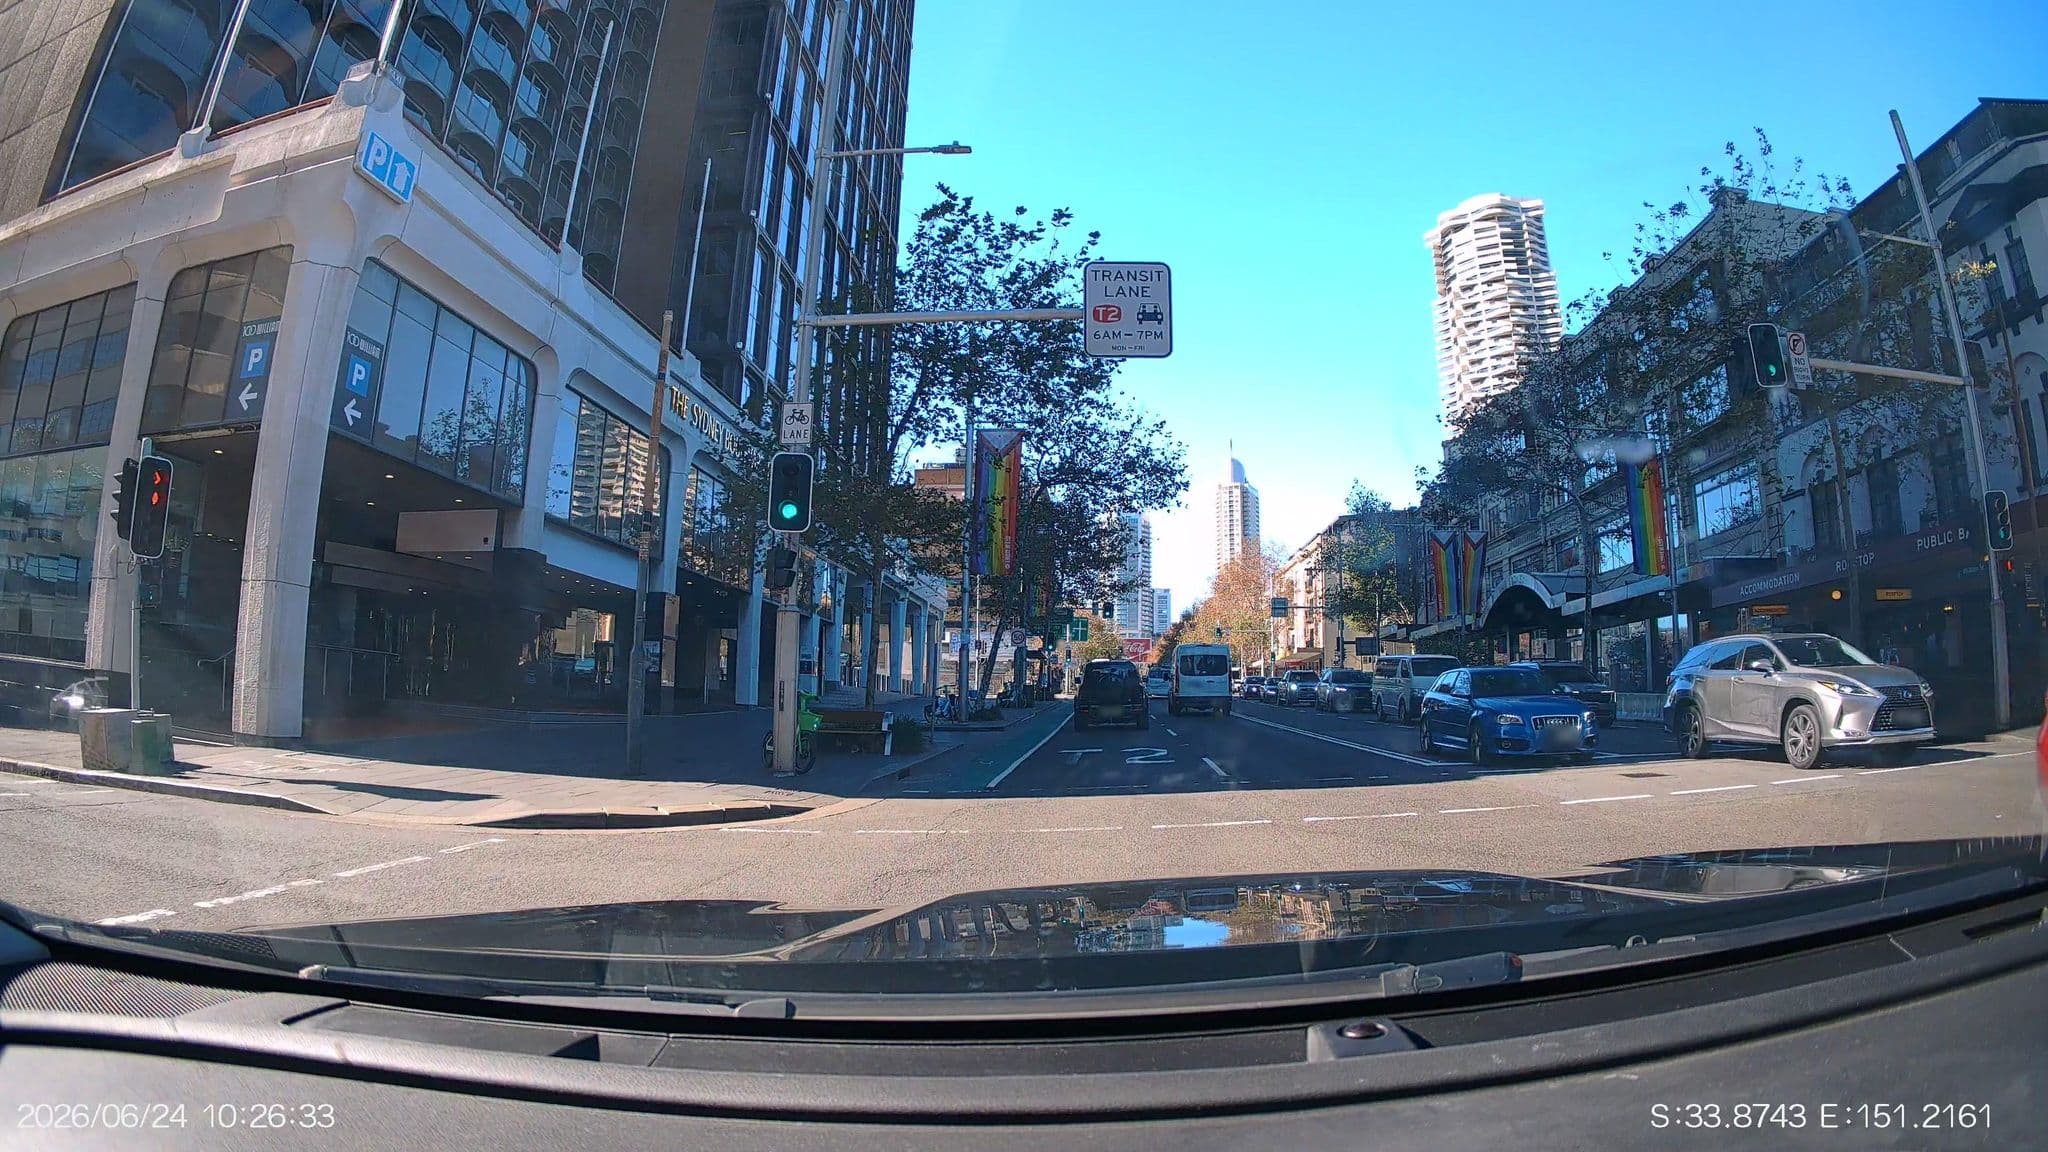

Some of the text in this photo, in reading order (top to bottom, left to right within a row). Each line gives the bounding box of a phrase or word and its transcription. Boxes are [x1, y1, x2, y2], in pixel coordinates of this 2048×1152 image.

[366, 135, 388, 171] P
[1091, 269, 1164, 282] TRANSIT
[1104, 285, 1151, 298] LANE
[1095, 307, 1120, 321] T2
[242, 324, 257, 338] 100
[247, 348, 263, 372] P
[1794, 357, 1806, 366] NO
[352, 362, 366, 386] P
[671, 385, 724, 444] THE SYDNEY
[783, 429, 809, 439] LANE
[1739, 571, 1800, 597] ACCOMMODATION
[1835, 552, 1875, 573] ROTOP
[1916, 530, 1953, 551] PUBLIC
[1013, 633, 1023, 641] 50
